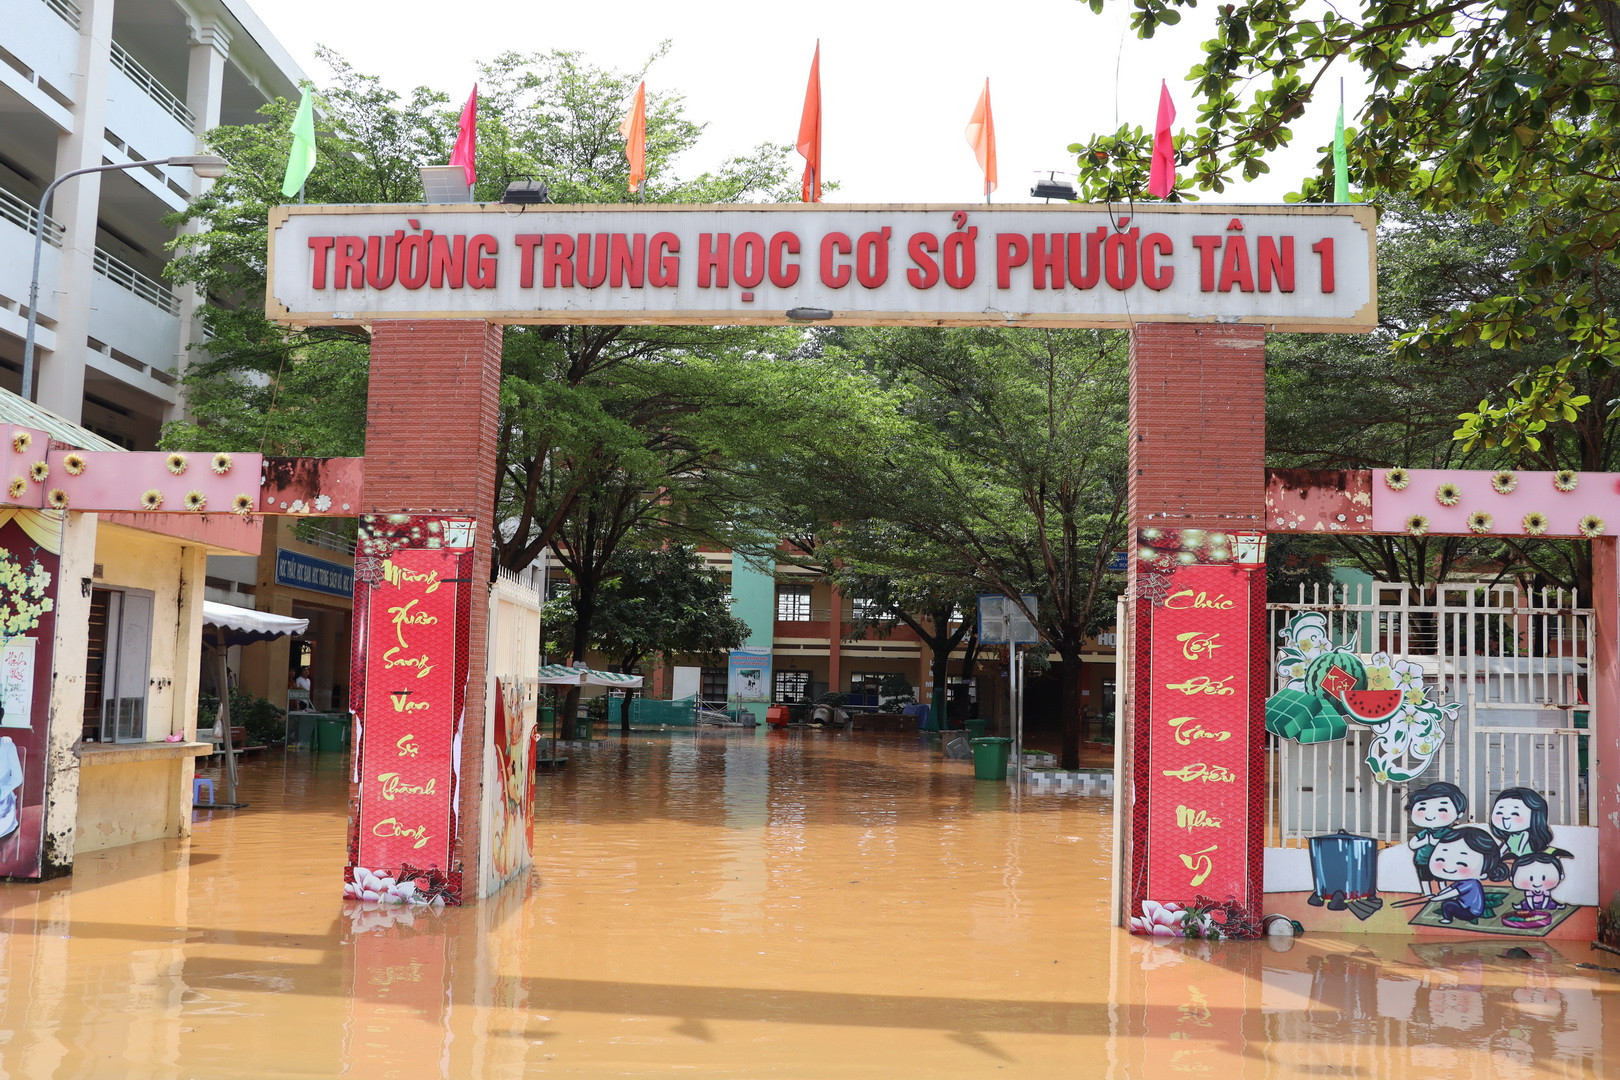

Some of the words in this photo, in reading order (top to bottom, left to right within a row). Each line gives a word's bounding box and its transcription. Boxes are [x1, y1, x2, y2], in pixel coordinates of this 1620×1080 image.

[308, 219, 498, 291] TRƯỜNG
[515, 231, 680, 290] TRUNG
[697, 231, 801, 302] HỌC
[819, 226, 891, 290] CƠ
[906, 210, 978, 290] SỞ
[996, 216, 1175, 292] PHƯỚC
[1193, 218, 1296, 293] TÂN
[1312, 237, 1335, 294] 1
[1164, 589, 1237, 610] Chúc
[388, 599, 438, 648] Xuân
[1176, 631, 1224, 660] Tết
[383, 646, 437, 678] Sang
[1165, 675, 1235, 695] Đến
[1327, 674, 1350, 692] Tết
[389, 688, 430, 714] Vạn
[396, 734, 420, 757] Sự
[377, 772, 436, 801] Thành
[1162, 762, 1236, 784] Điều
[372, 817, 435, 849] Công
[1175, 804, 1223, 834] Như
[1178, 844, 1219, 887] Ý
